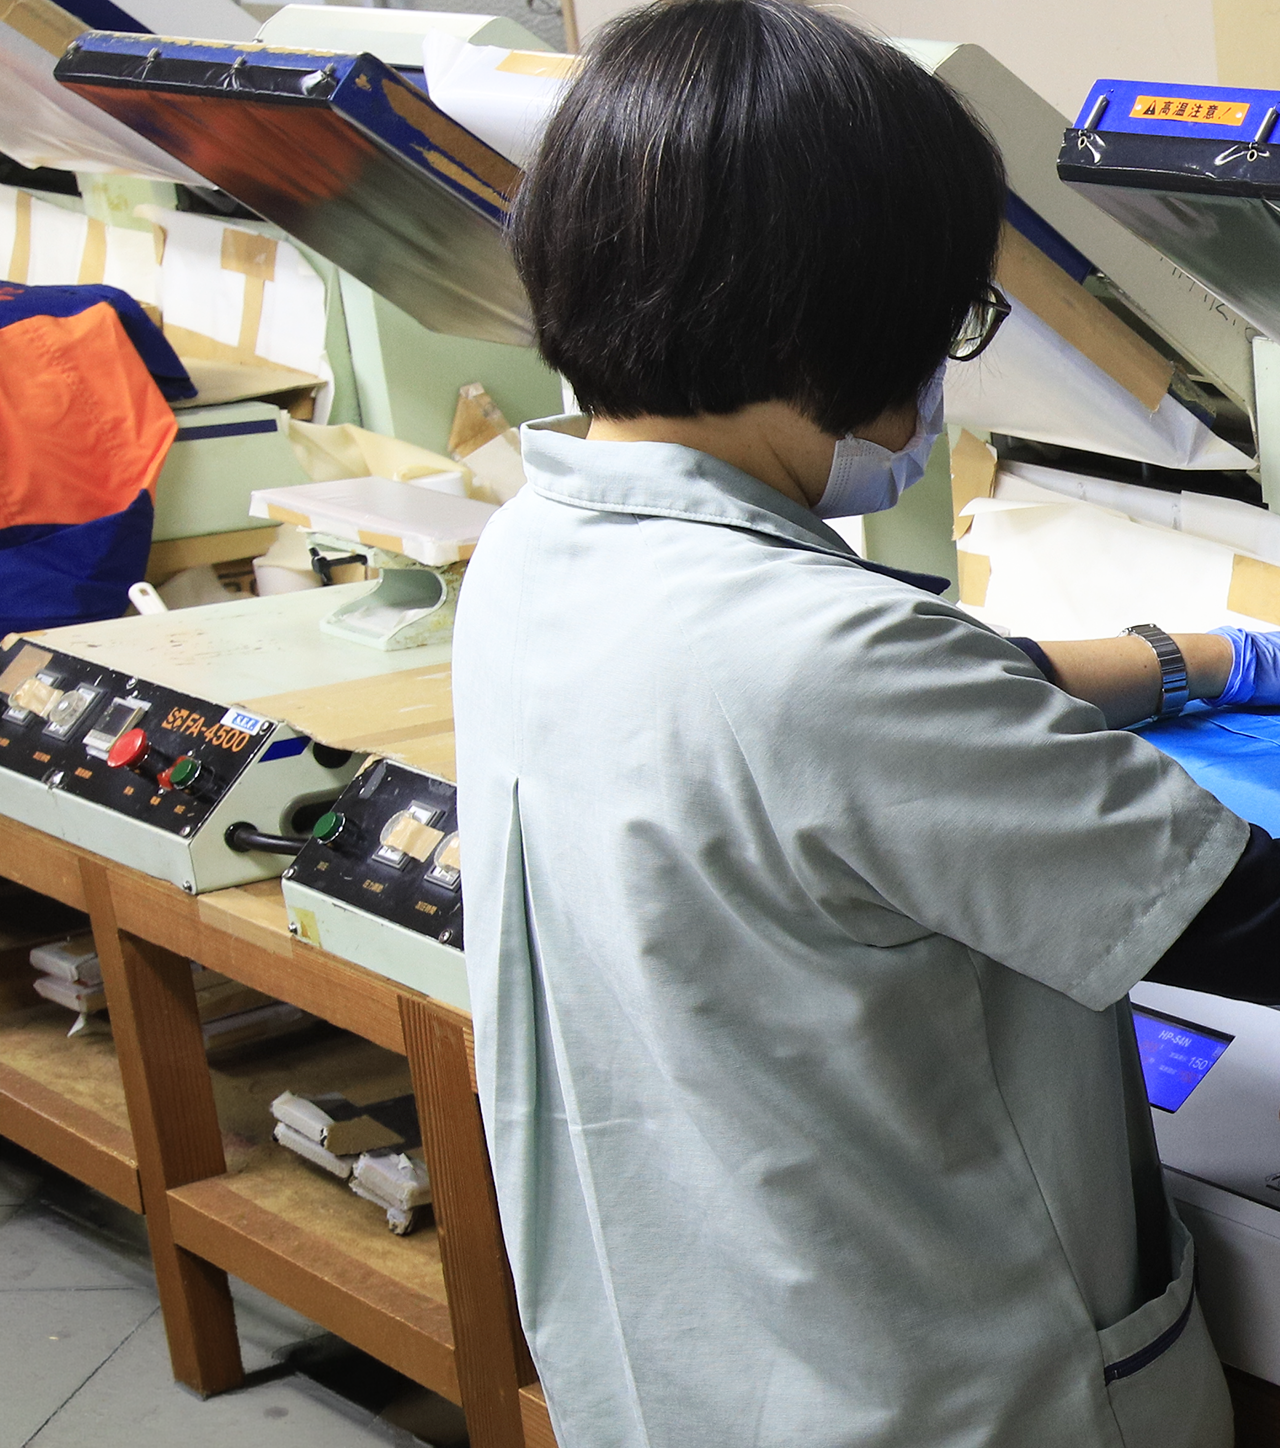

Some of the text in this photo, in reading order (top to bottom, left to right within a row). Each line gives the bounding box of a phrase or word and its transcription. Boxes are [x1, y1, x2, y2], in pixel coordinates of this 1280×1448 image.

[180, 713, 250, 752] FA-4500
[1158, 1030, 1192, 1047] HP-54N
[1188, 1056, 1208, 1070] 150
